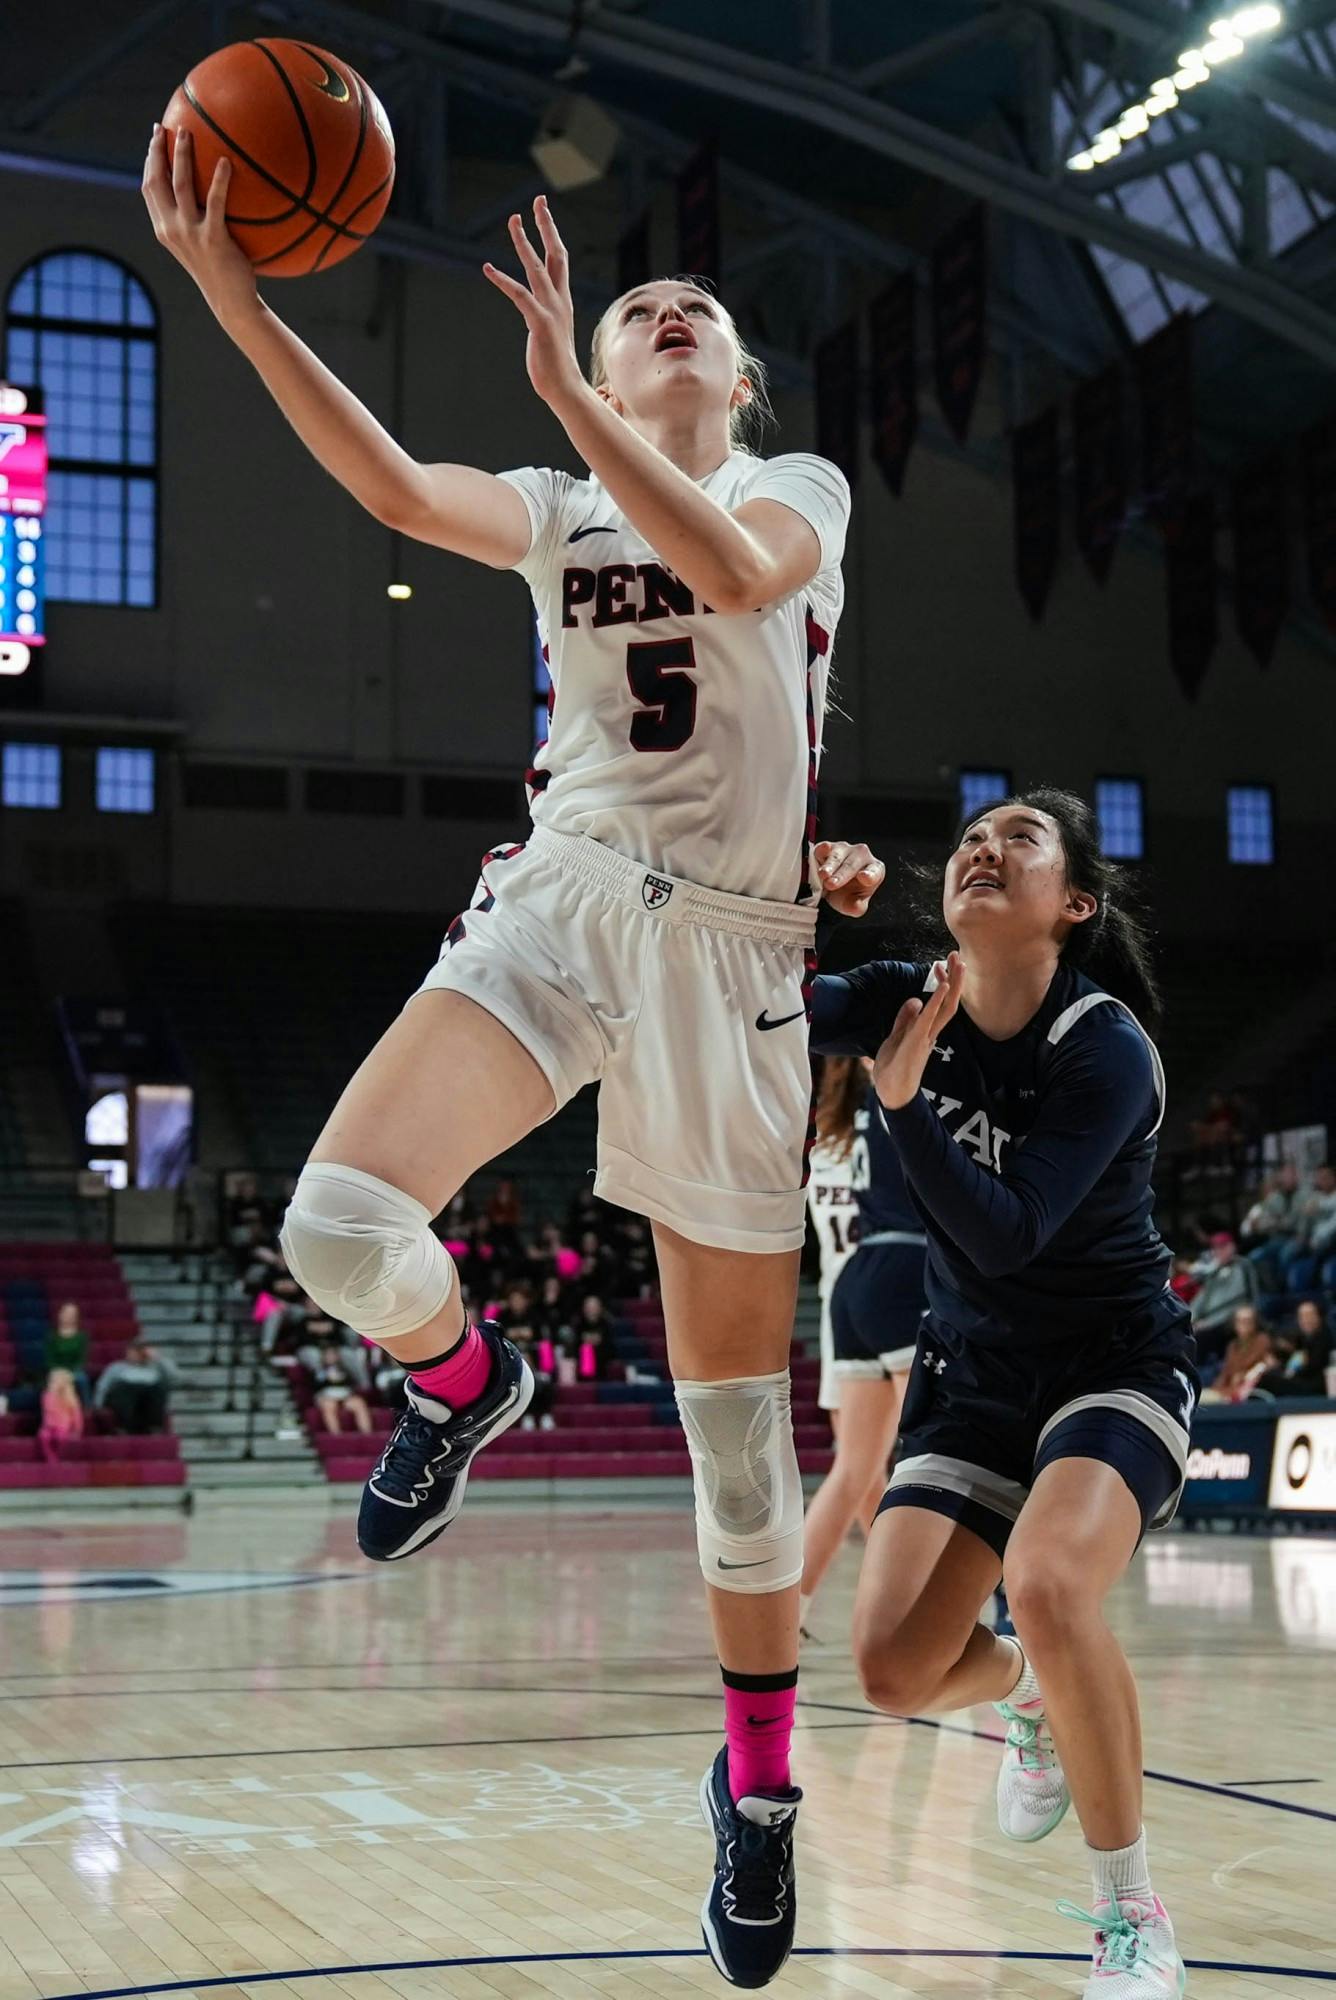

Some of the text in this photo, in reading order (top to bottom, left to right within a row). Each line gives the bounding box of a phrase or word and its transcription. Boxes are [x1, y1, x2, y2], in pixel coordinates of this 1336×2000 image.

[561, 563, 762, 629] PEN
[626, 636, 698, 753] 5
[646, 876, 672, 891] PENN
[646, 887, 663, 905] P
